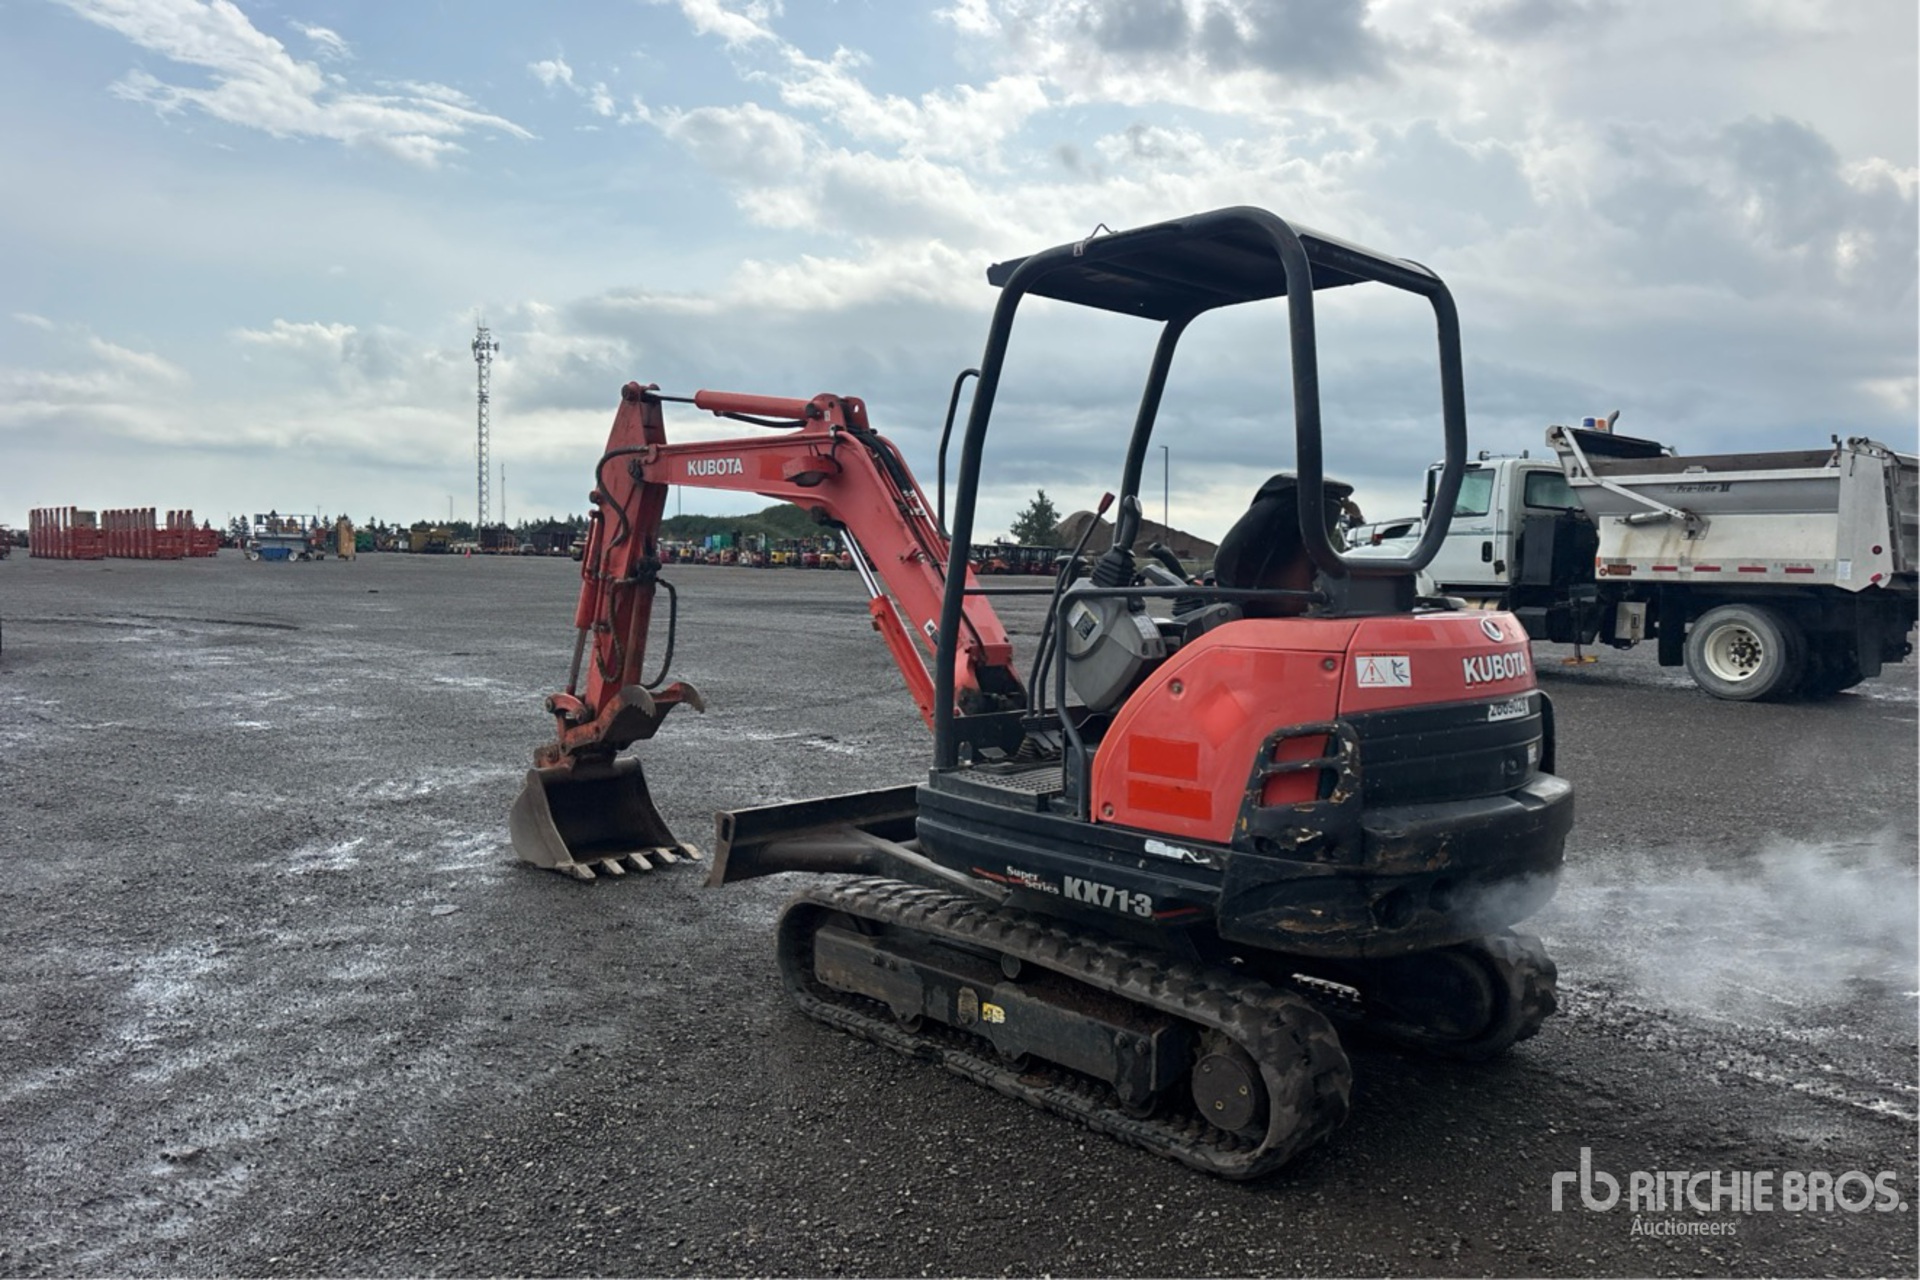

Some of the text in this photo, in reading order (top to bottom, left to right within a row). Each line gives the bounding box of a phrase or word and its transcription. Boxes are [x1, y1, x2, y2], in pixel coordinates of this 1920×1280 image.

[687, 457, 744, 476] KUBOTA
[1462, 651, 1528, 684] KUBOTA
[1006, 865, 1040, 882] Super
[1024, 878, 1060, 895] Series
[1063, 875, 1153, 918] KX71-3
